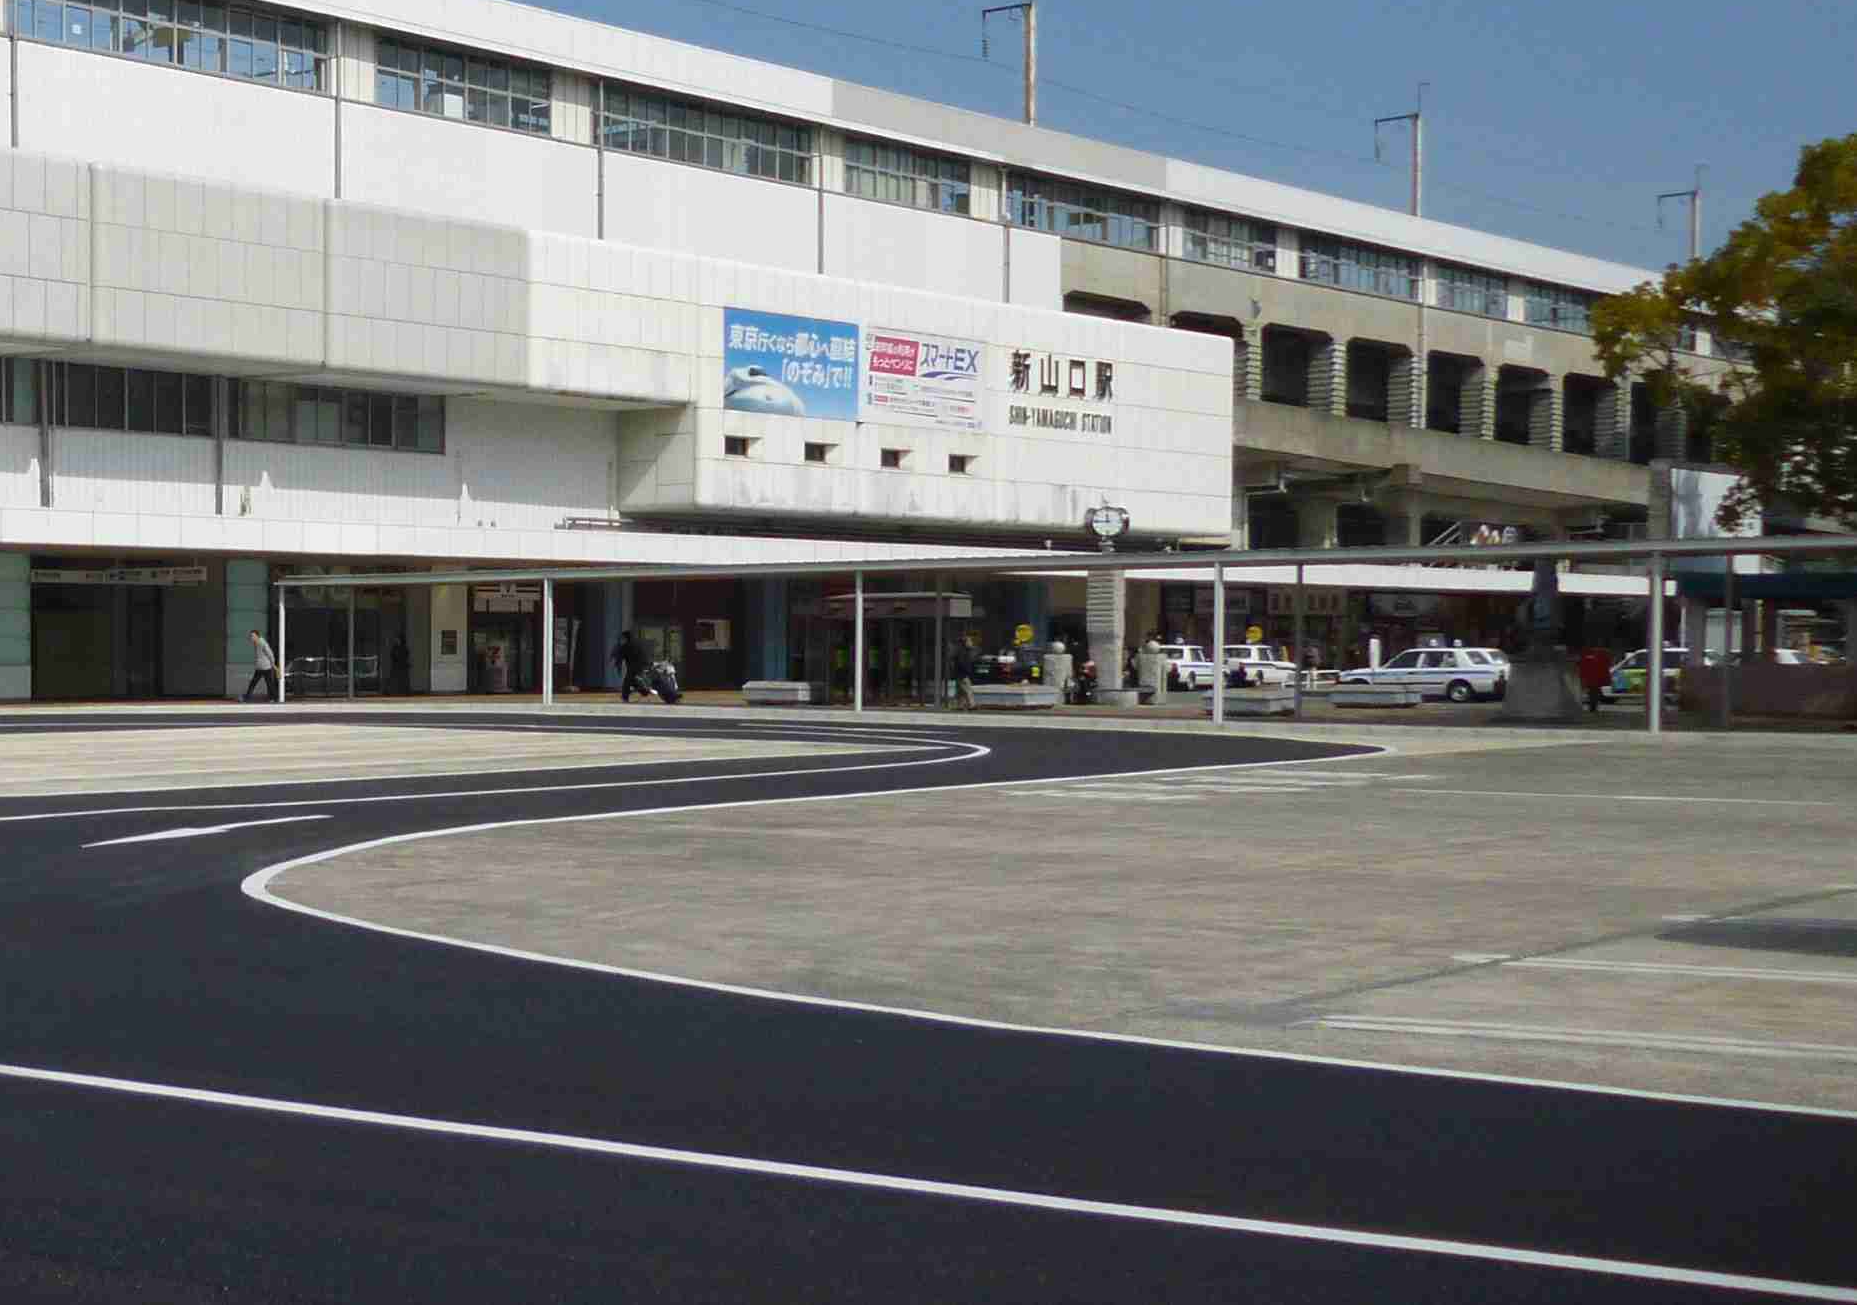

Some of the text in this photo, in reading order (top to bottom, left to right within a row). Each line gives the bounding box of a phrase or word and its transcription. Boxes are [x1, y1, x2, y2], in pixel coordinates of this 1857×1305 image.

[1009, 349, 1113, 400] 新山口駅
[1081, 411, 1111, 434] STATION
